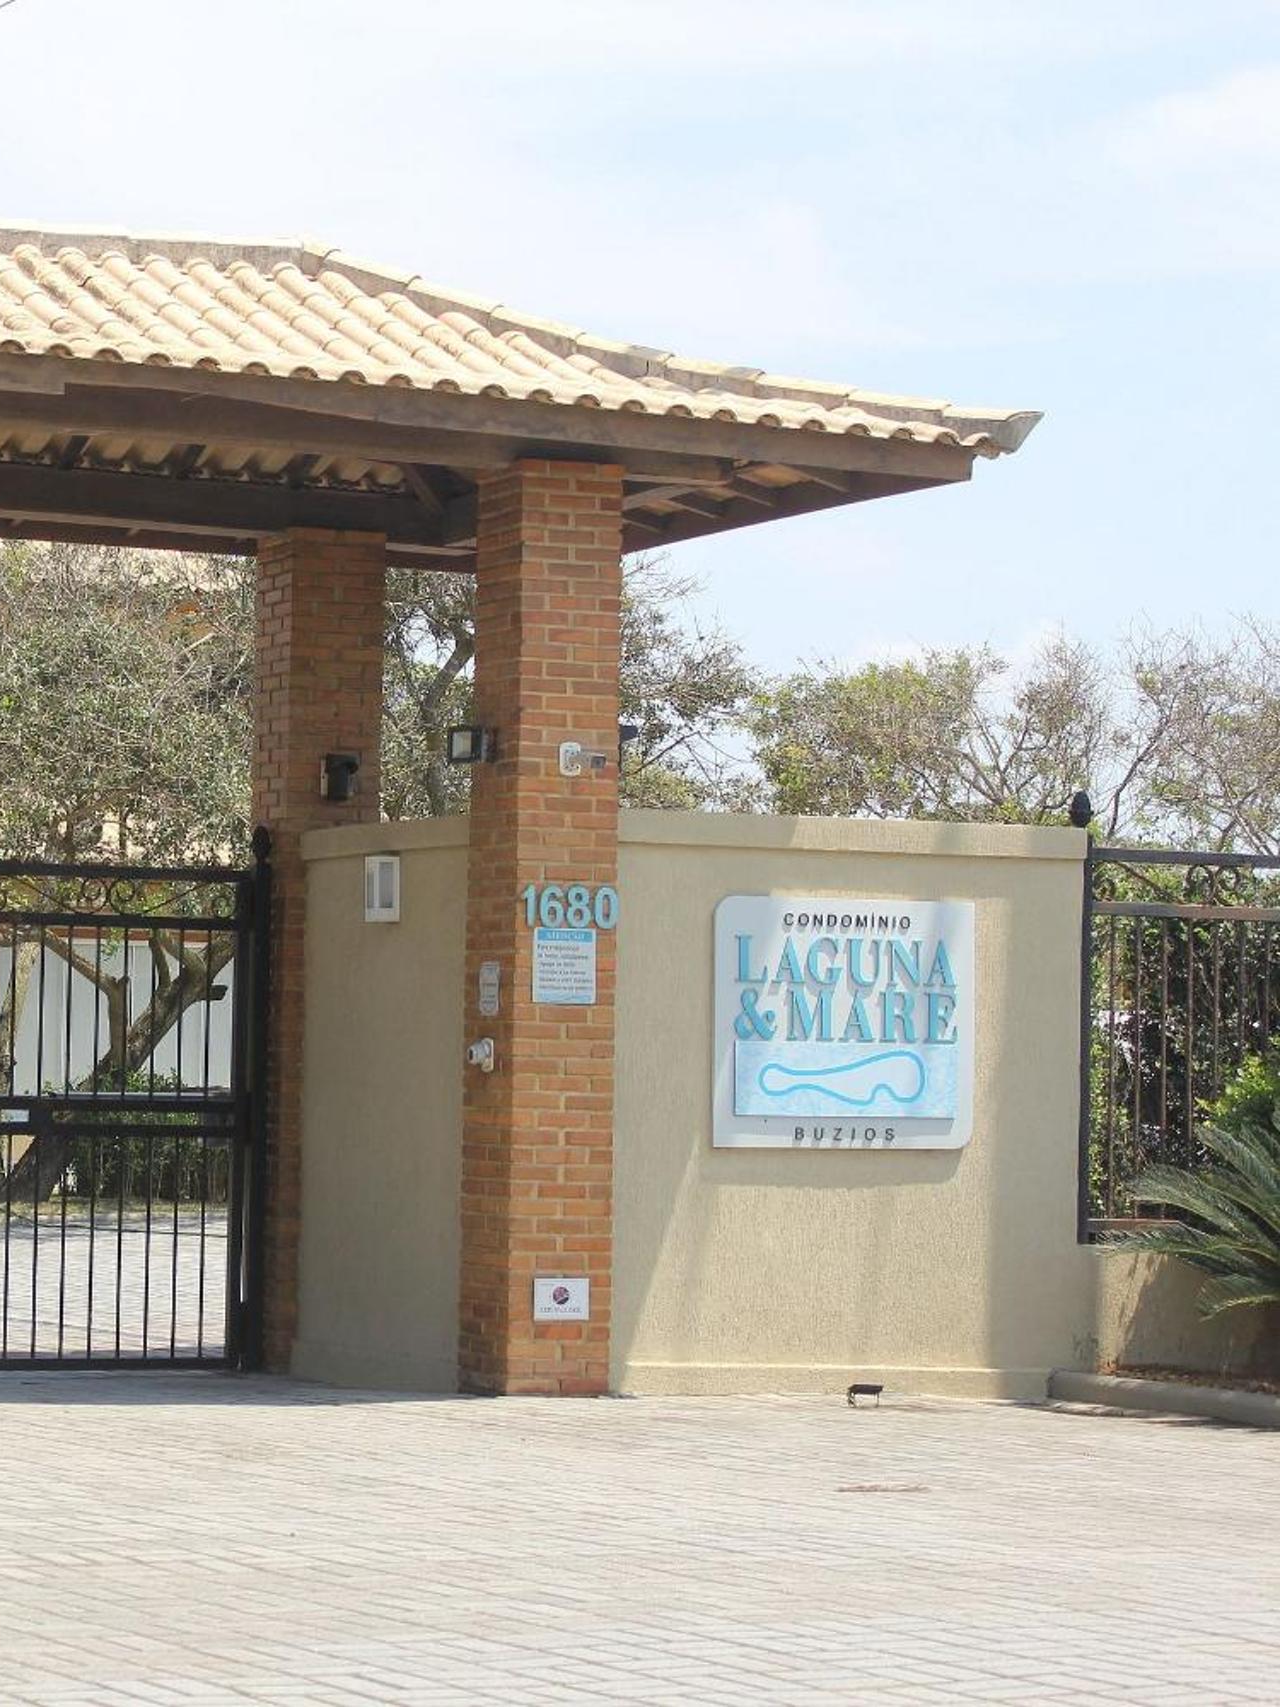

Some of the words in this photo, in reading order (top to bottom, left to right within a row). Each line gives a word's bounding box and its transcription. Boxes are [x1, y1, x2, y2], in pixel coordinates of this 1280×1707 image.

[523, 884, 619, 929] 1680
[783, 911, 912, 930] CONDOMÍNIO
[734, 935, 957, 988] LAGUNA
[733, 987, 776, 1042] &
[784, 989, 959, 1045] MARE
[794, 1127, 896, 1142] BUZIOS
